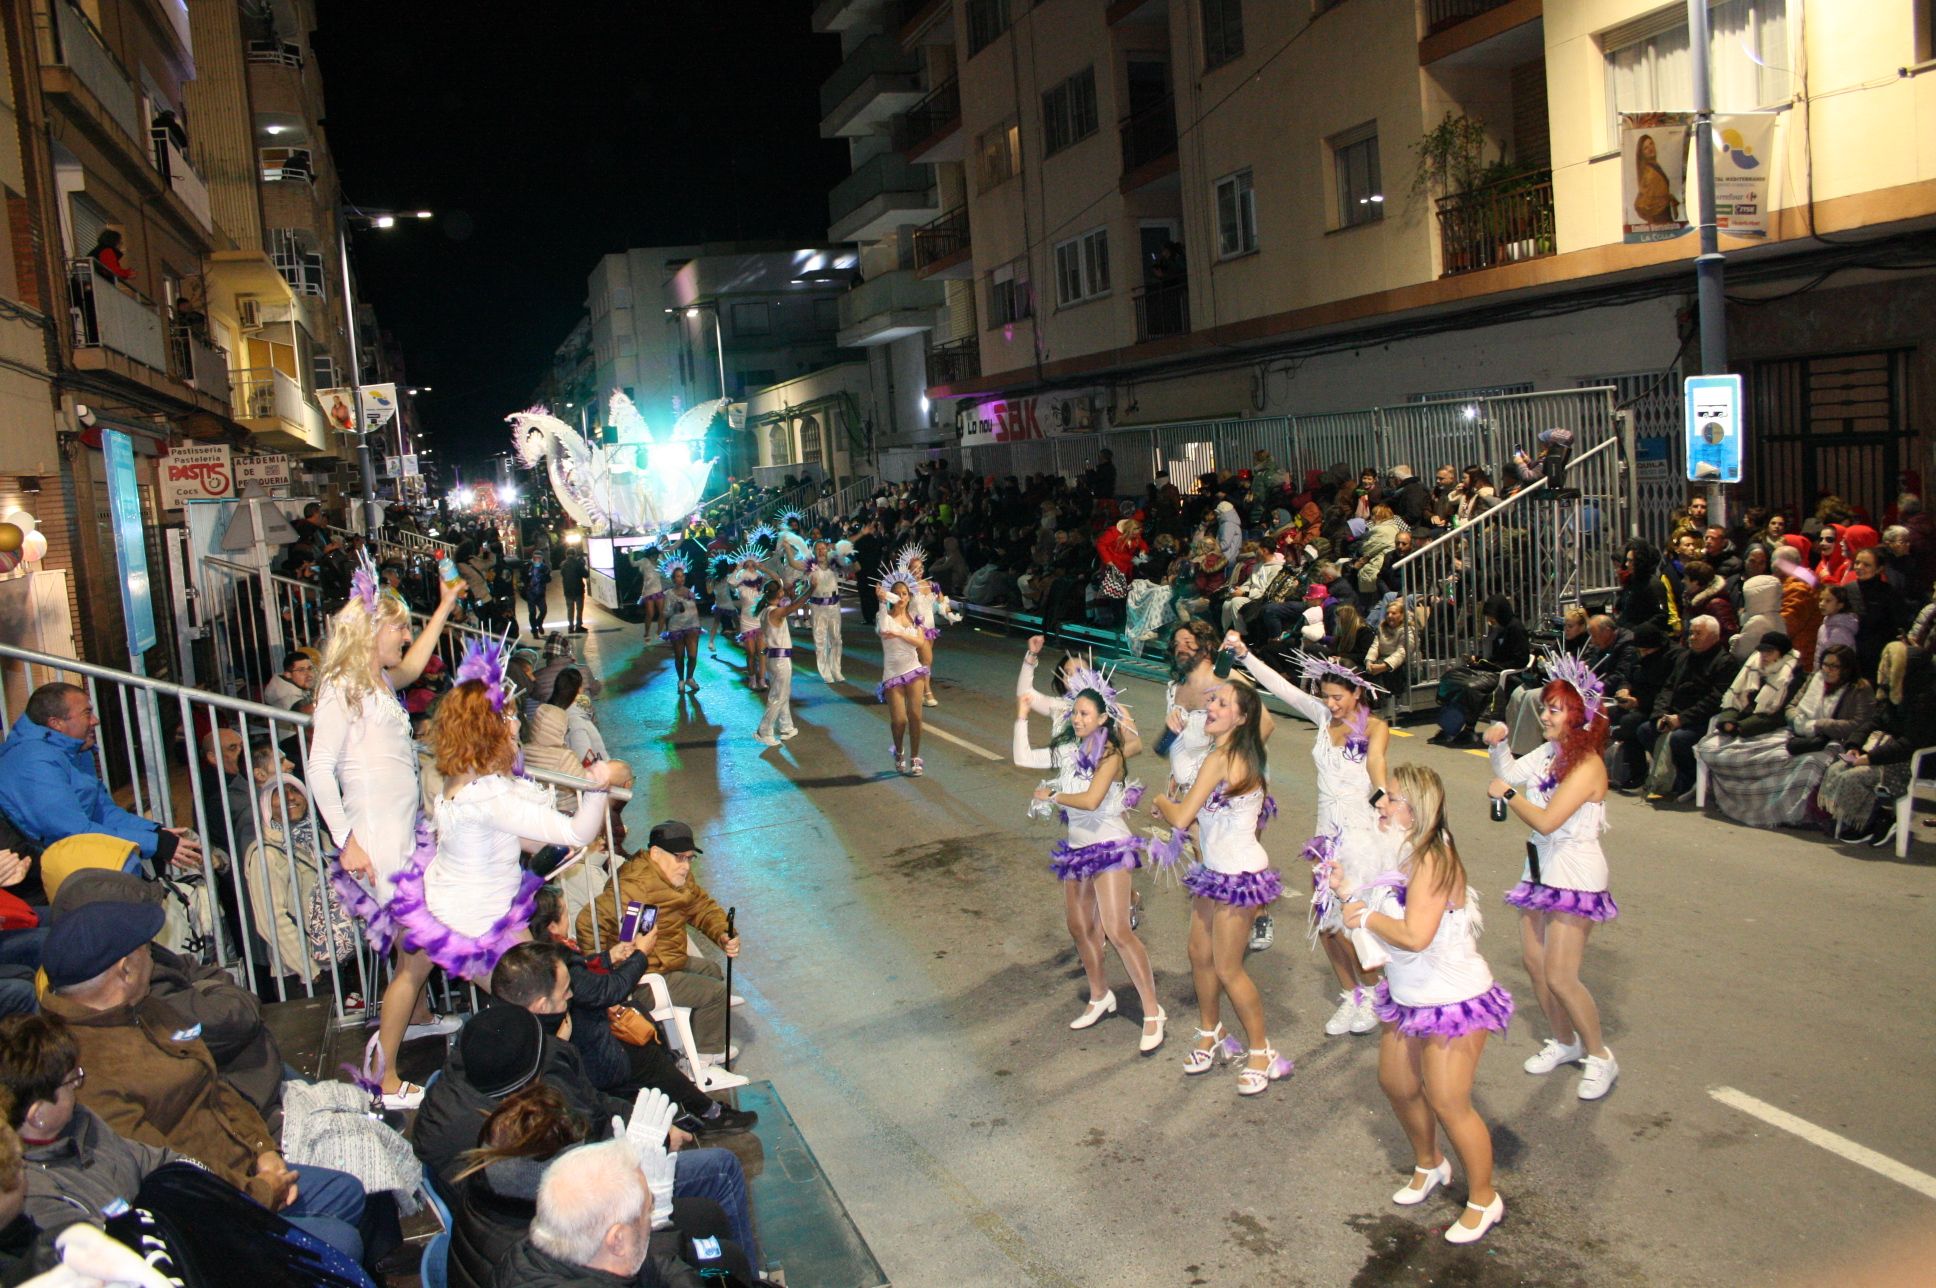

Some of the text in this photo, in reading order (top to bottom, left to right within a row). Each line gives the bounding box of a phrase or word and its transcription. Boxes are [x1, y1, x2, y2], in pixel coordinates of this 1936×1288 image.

[994, 397, 1043, 442] SBK
[171, 447, 222, 455] Pastisseria
[175, 456, 221, 464] Pasteleria
[236, 456, 286, 465] ACADEMIA
[168, 463, 230, 496] PASTIS
